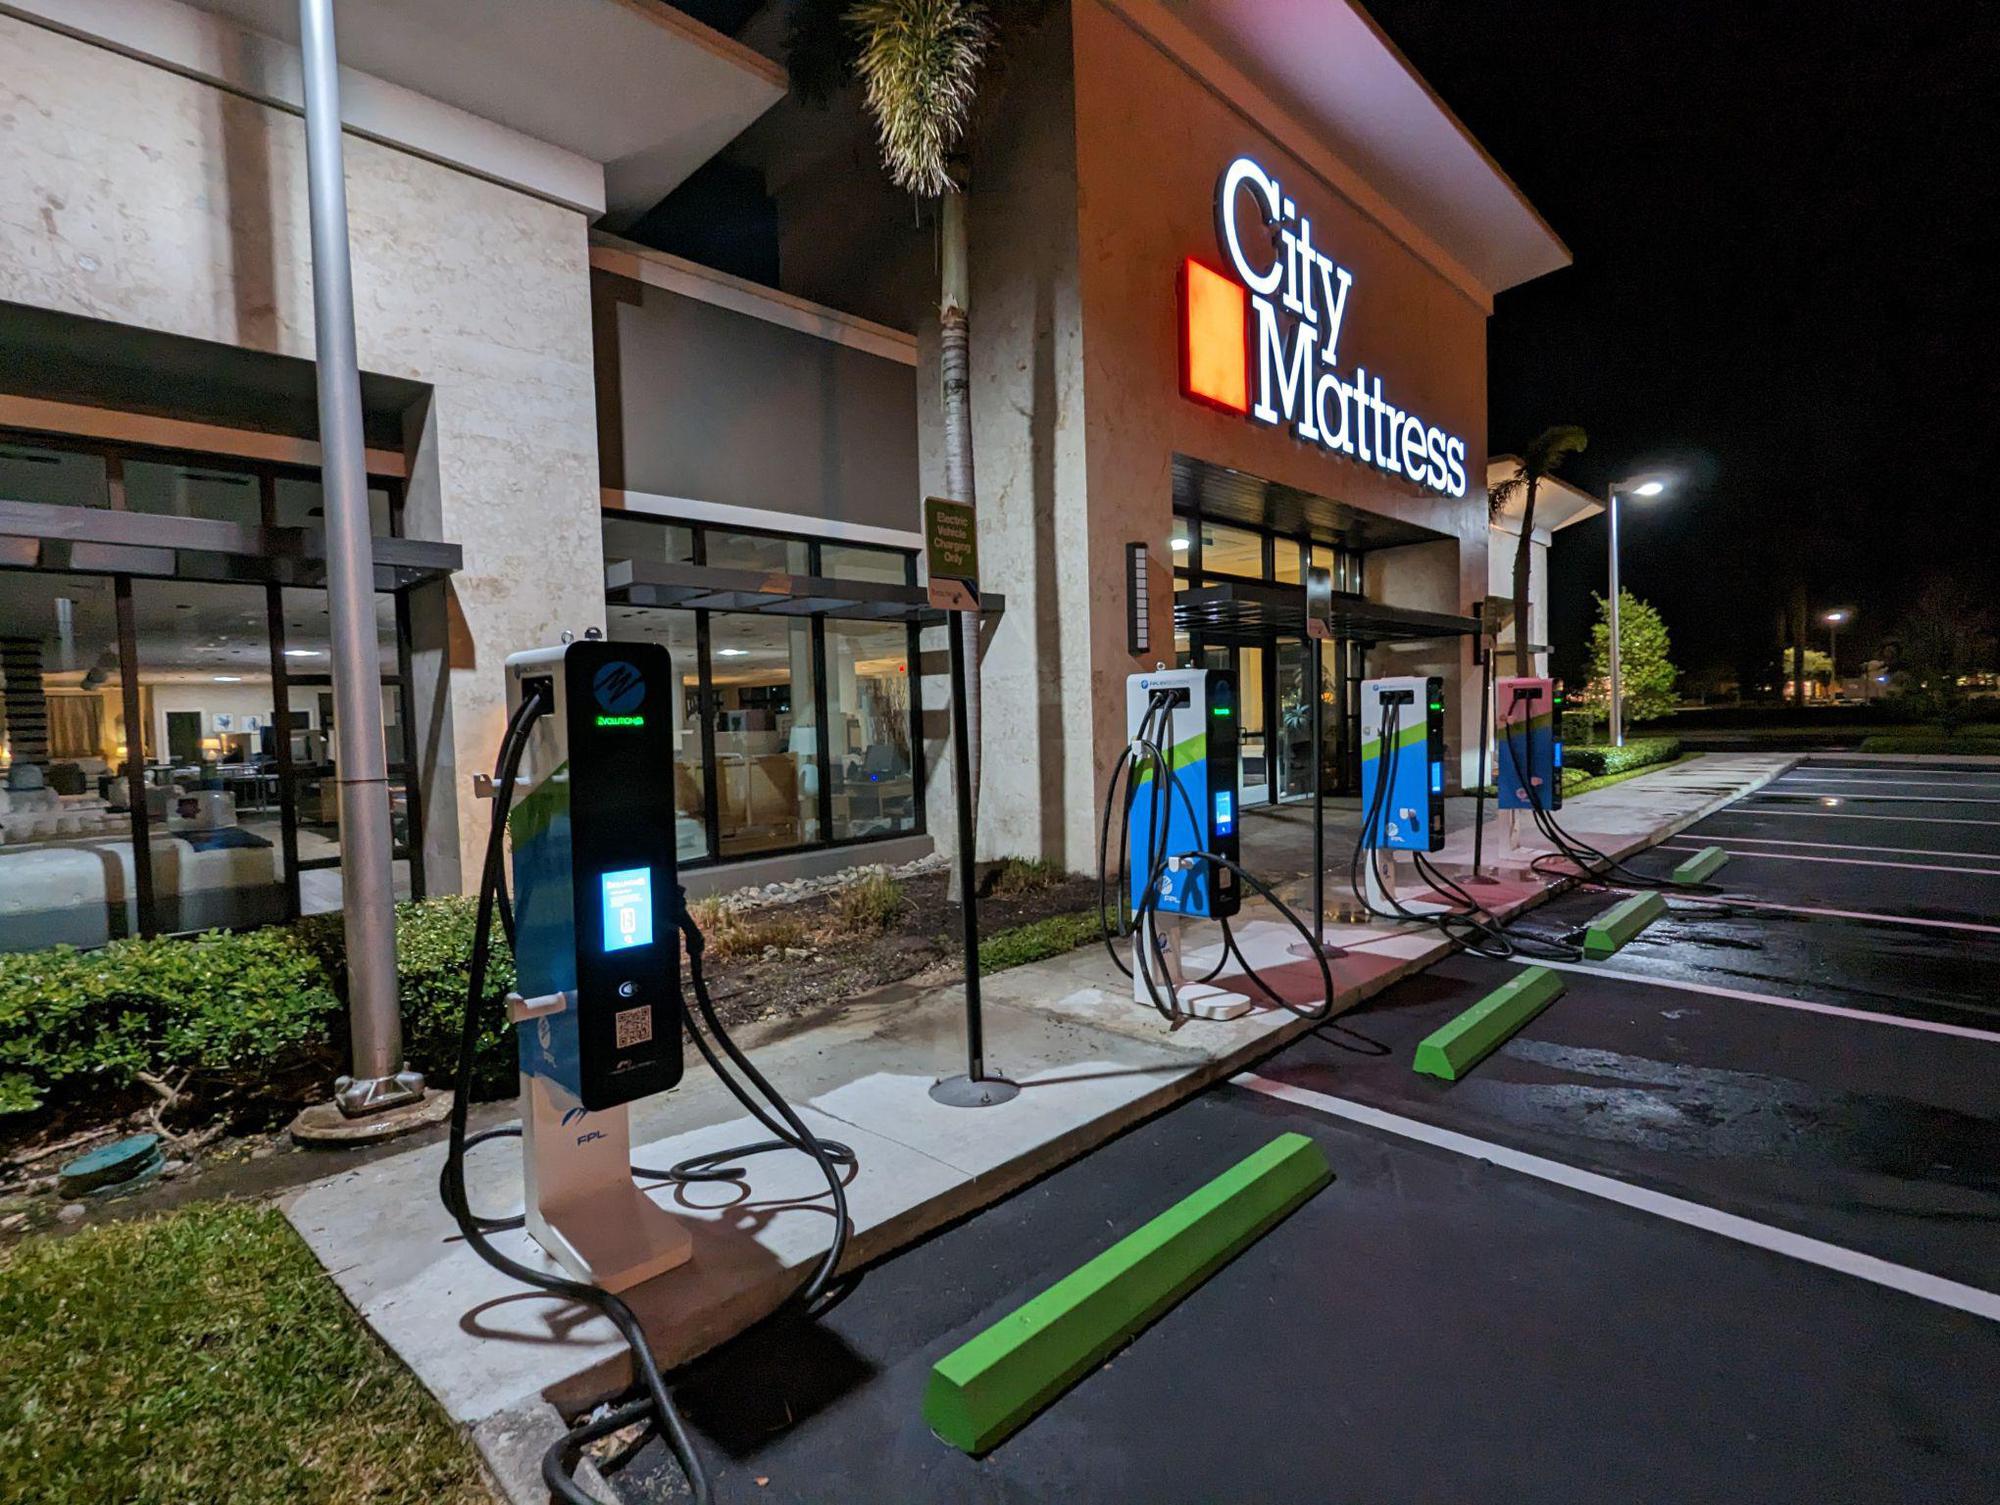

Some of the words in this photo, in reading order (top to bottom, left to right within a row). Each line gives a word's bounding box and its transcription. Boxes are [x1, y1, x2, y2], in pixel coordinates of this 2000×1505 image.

[1222, 157, 1352, 366] City
[1252, 294, 1466, 498] Mattress
[936, 511, 968, 527] Electric
[937, 525, 967, 539] Vehicle
[934, 537, 971, 554] Charging
[944, 551, 963, 566] Only
[577, 1130, 608, 1145] FPL
